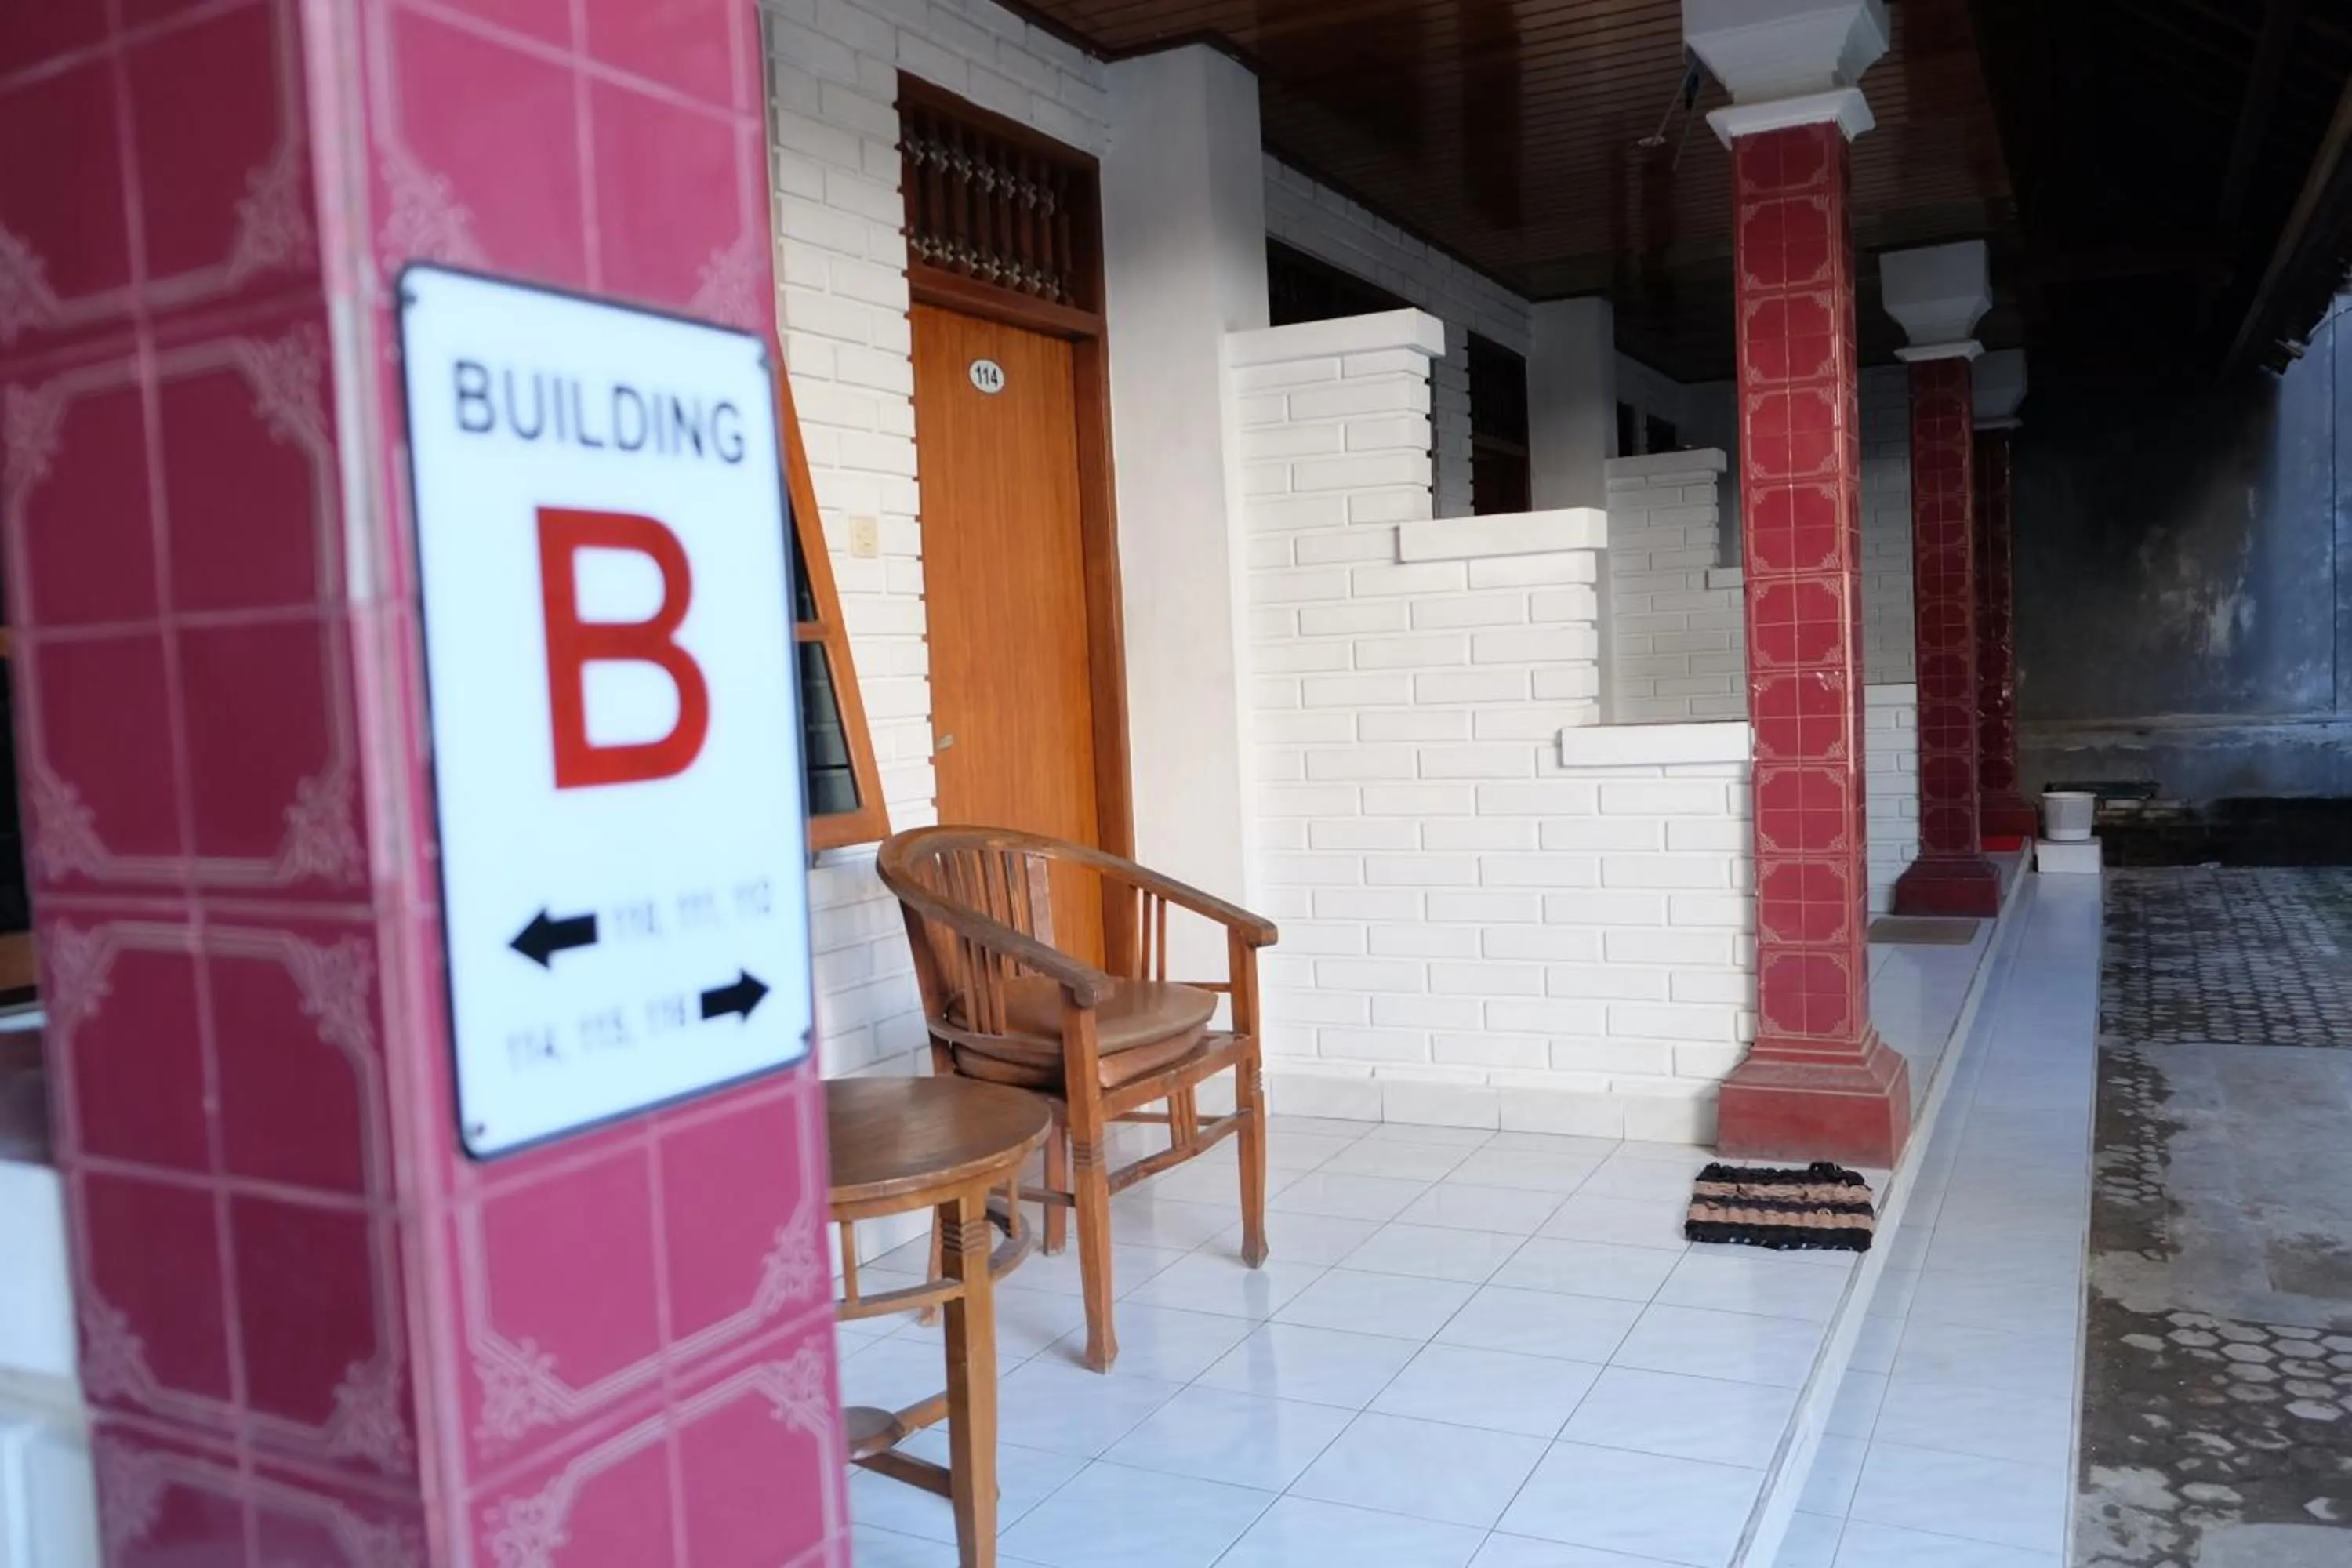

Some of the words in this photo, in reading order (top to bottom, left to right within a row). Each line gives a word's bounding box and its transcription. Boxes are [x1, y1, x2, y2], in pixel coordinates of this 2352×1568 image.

[452, 360, 745, 464] BUILDING
[975, 365, 998, 386] 114
[535, 505, 710, 789] B
